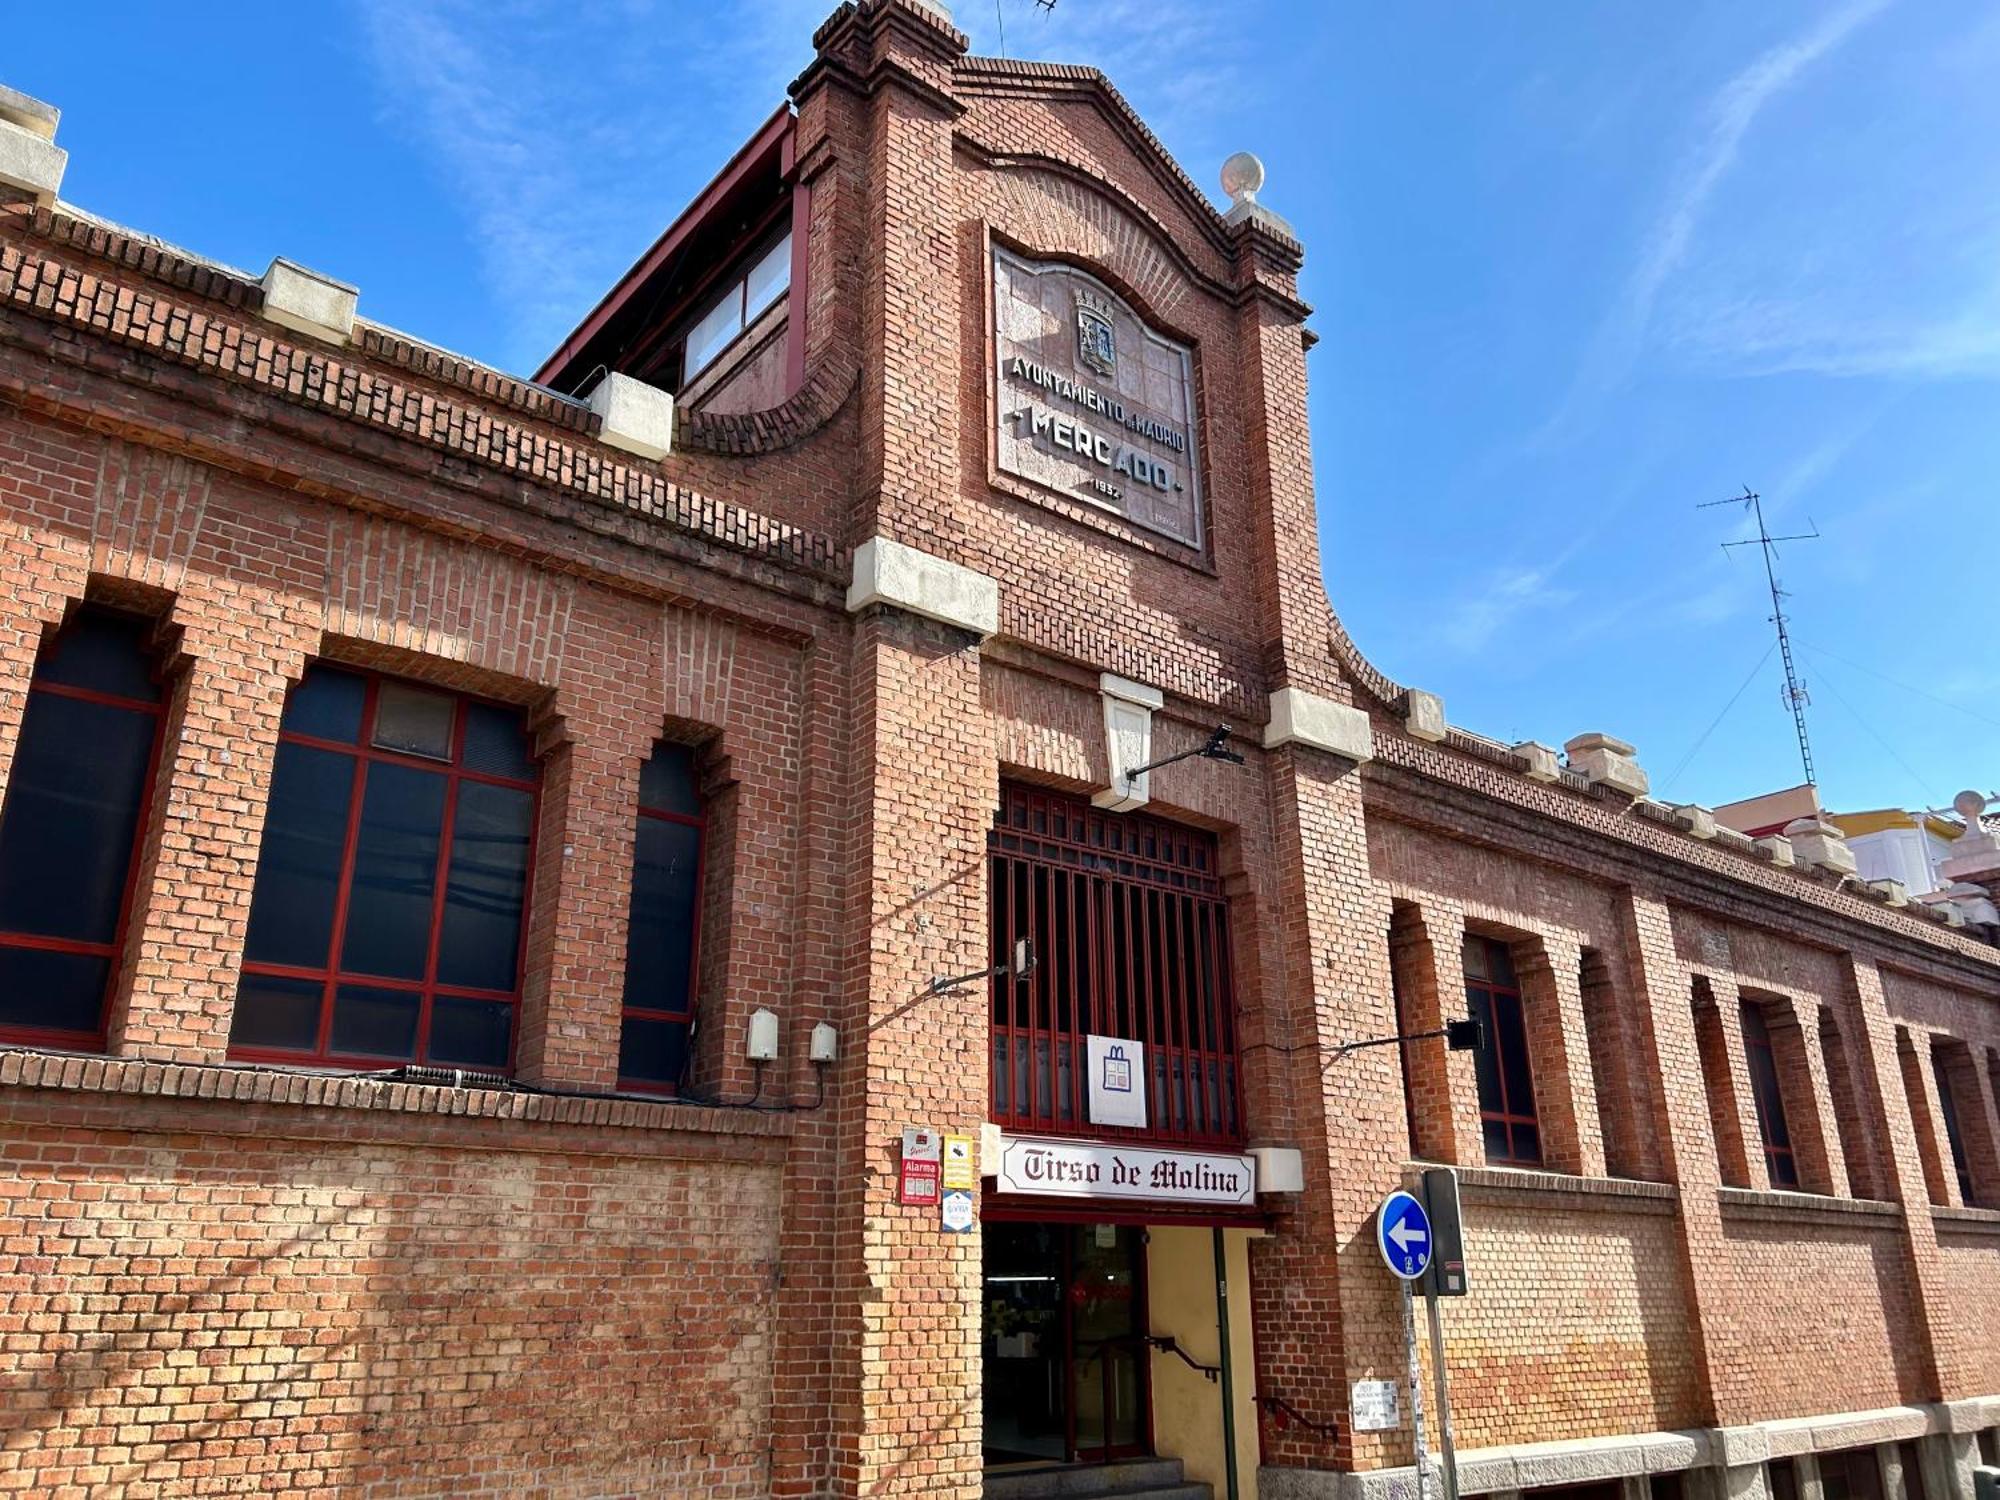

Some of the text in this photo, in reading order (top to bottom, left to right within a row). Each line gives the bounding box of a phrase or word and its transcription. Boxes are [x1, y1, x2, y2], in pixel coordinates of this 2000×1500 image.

[1012, 356, 1125, 422] AYUNTAMIENTO
[1136, 418, 1184, 452] MADRID
[1031, 408, 1168, 491] MERCADO
[1095, 478, 1120, 498] 1932
[905, 1161, 936, 1173] Alarma
[1024, 1148, 1239, 1193] Tirso de Molina
